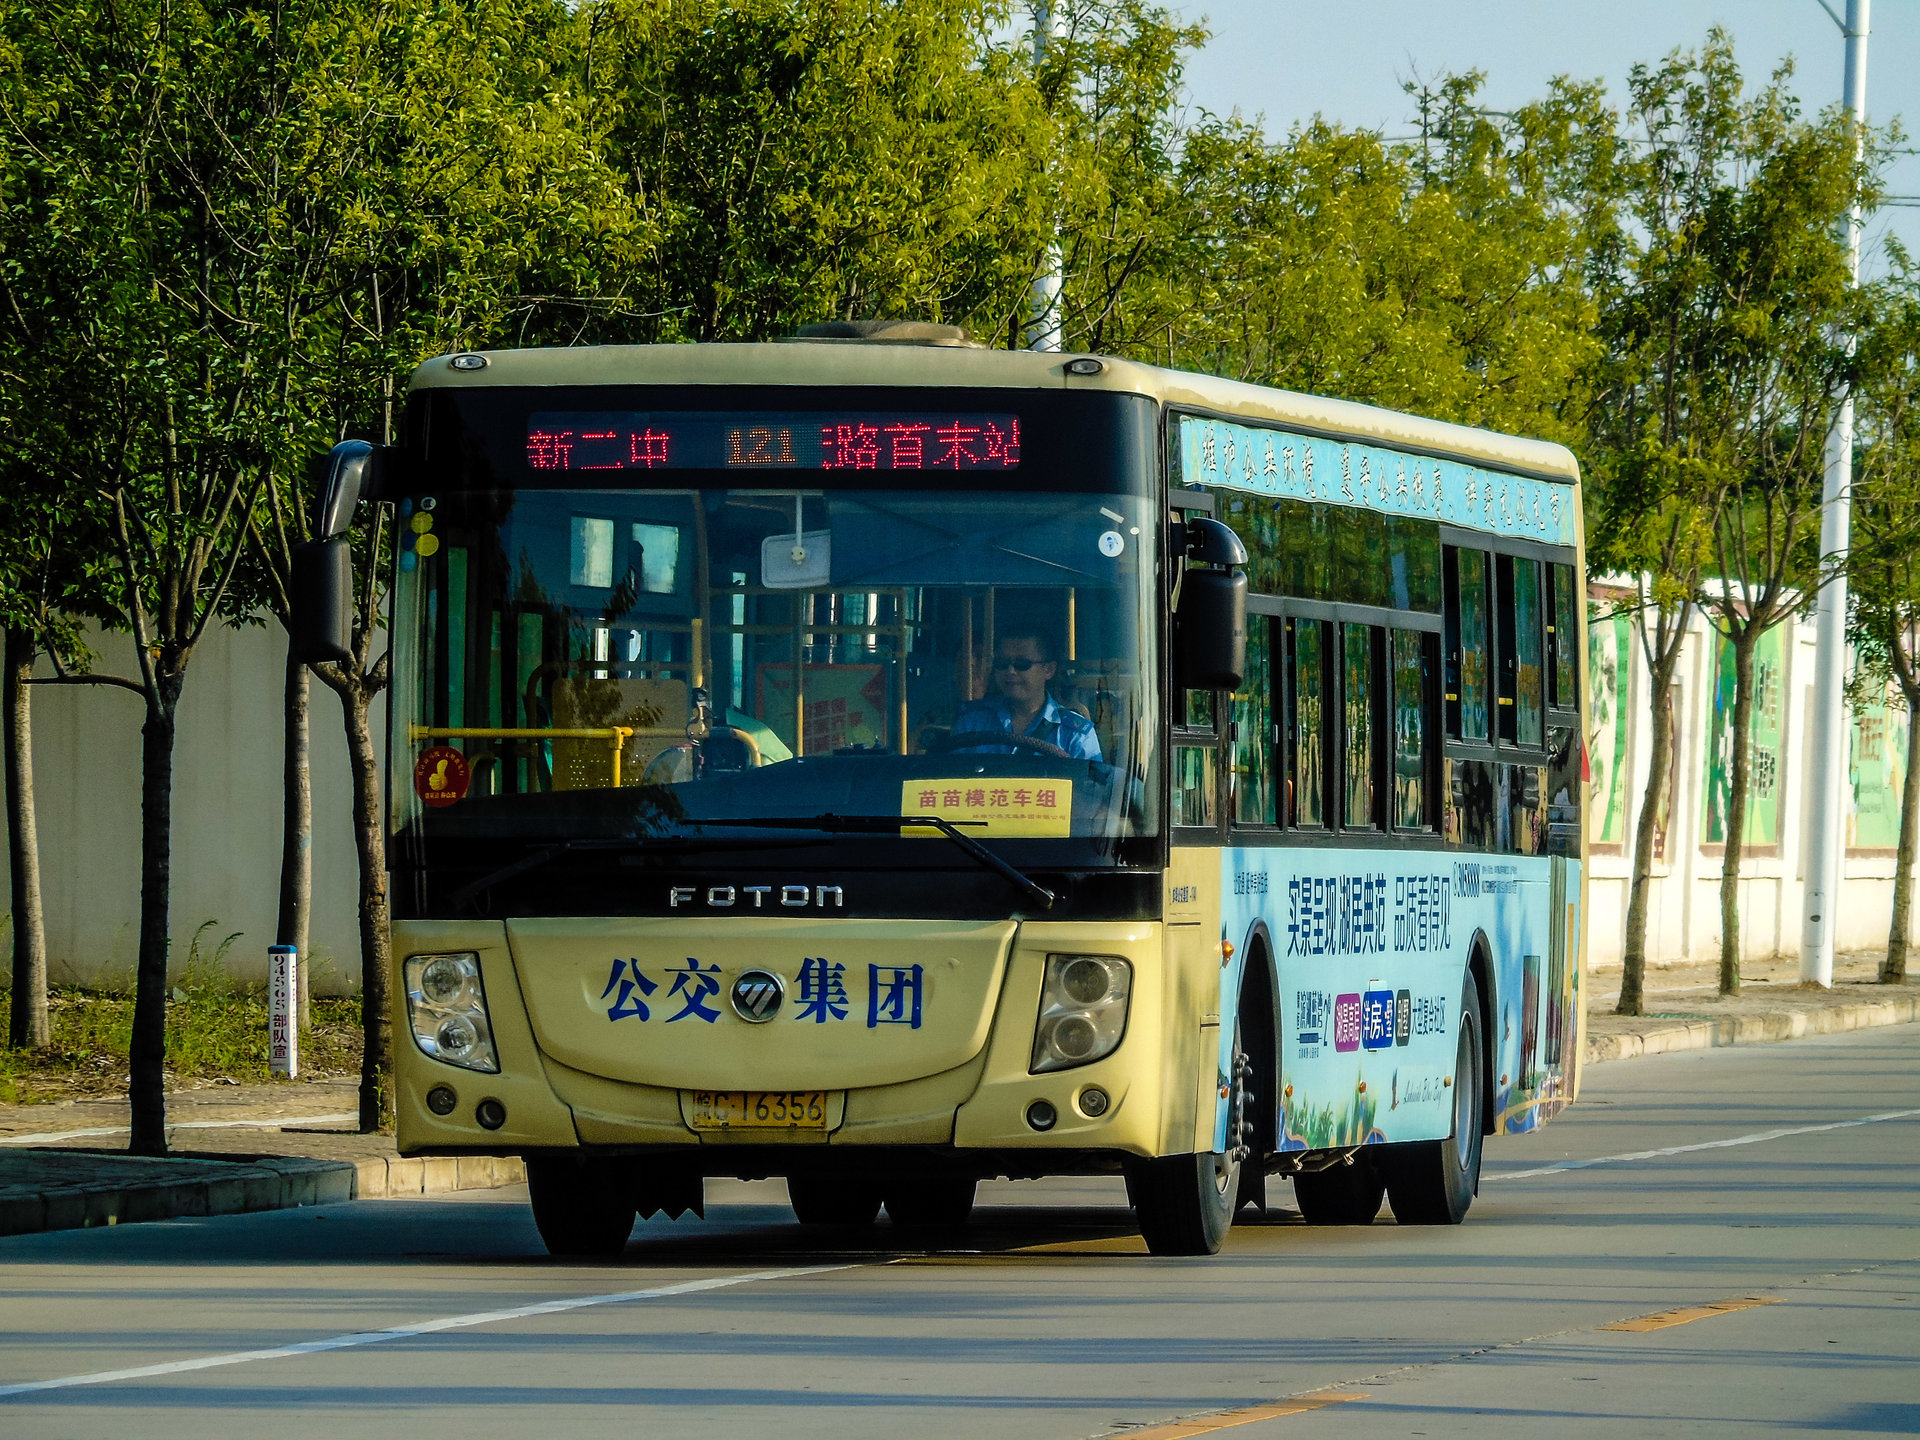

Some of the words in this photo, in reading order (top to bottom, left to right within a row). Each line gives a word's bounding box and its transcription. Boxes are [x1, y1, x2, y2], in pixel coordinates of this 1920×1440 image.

[527, 430, 669, 469] 新二中
[728, 430, 796, 463] 121
[918, 789, 1057, 808] 苗苗模范车组
[670, 886, 843, 907] FOTON
